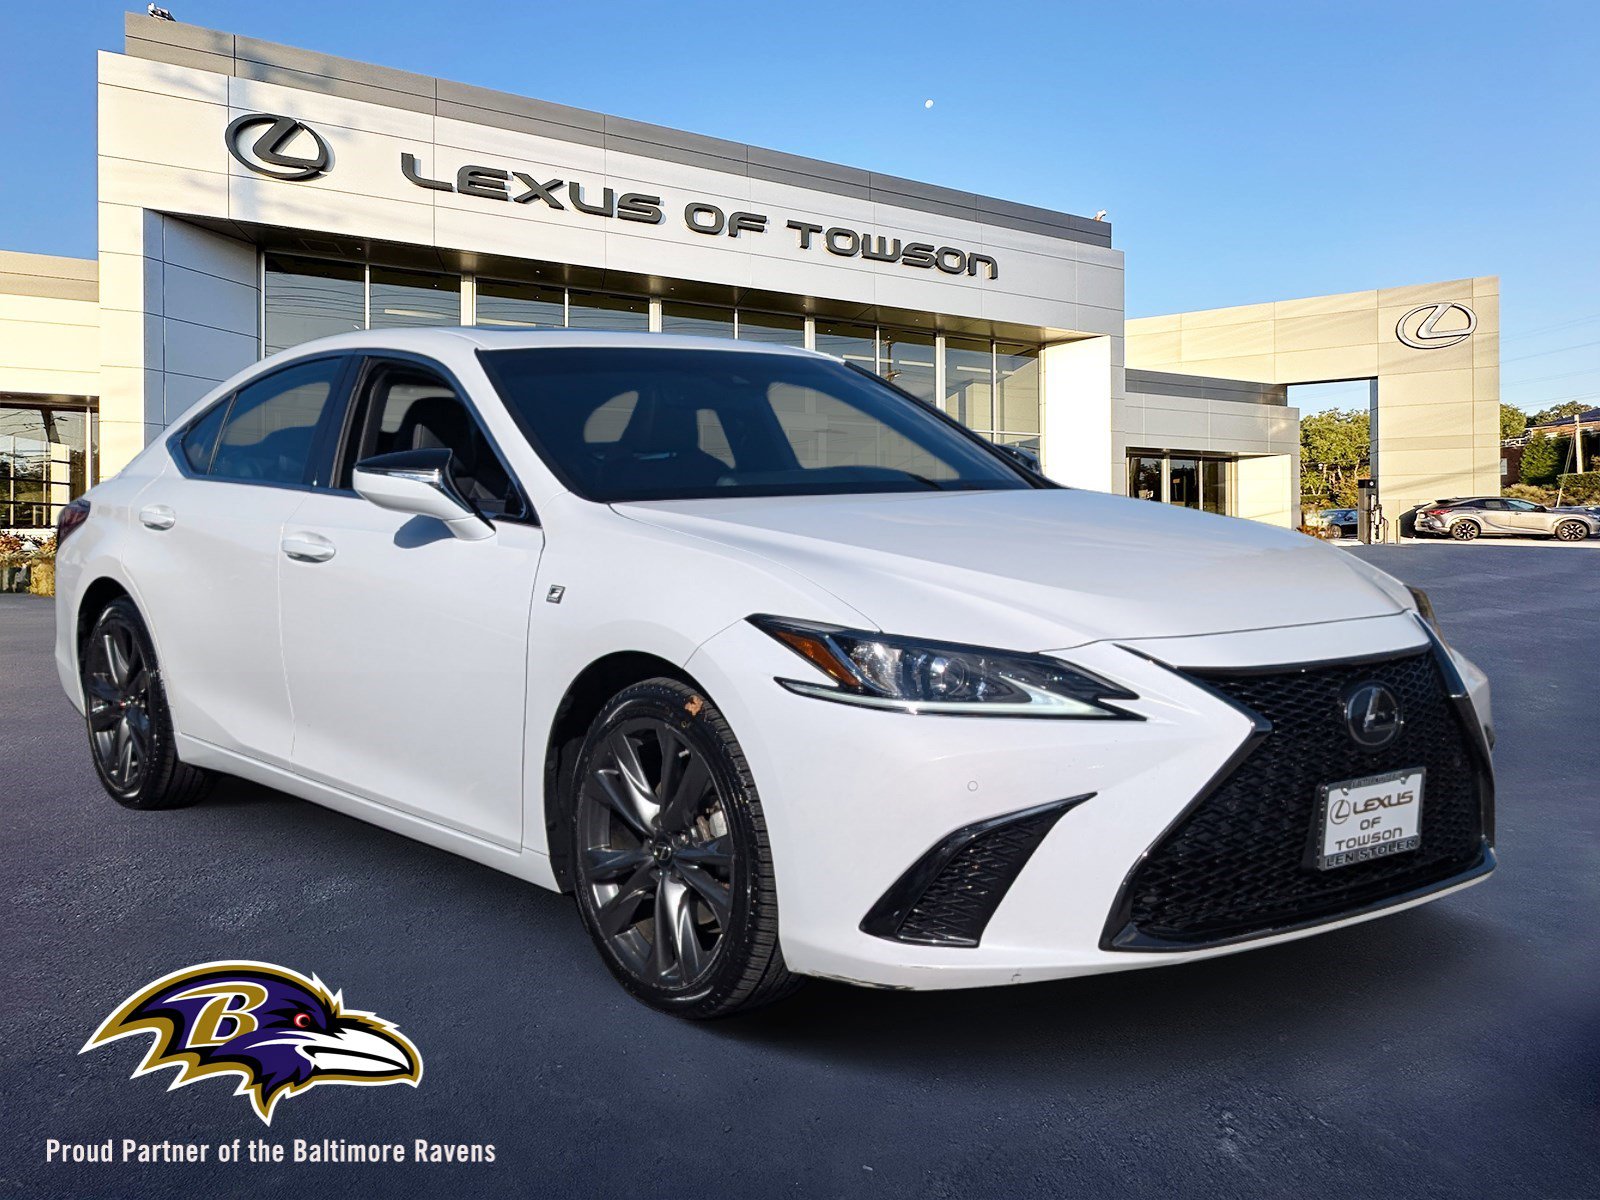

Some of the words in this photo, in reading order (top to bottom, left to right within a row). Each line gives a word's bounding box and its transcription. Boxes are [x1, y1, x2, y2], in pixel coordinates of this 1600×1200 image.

[400, 152, 664, 225] LEXUS
[684, 202, 767, 238] OF
[786, 219, 998, 281] TOWSON
[1353, 790, 1413, 815] LEXUS
[1360, 816, 1382, 830] OF
[1335, 827, 1402, 851] TOWSON
[1326, 852, 1354, 868] LEN
